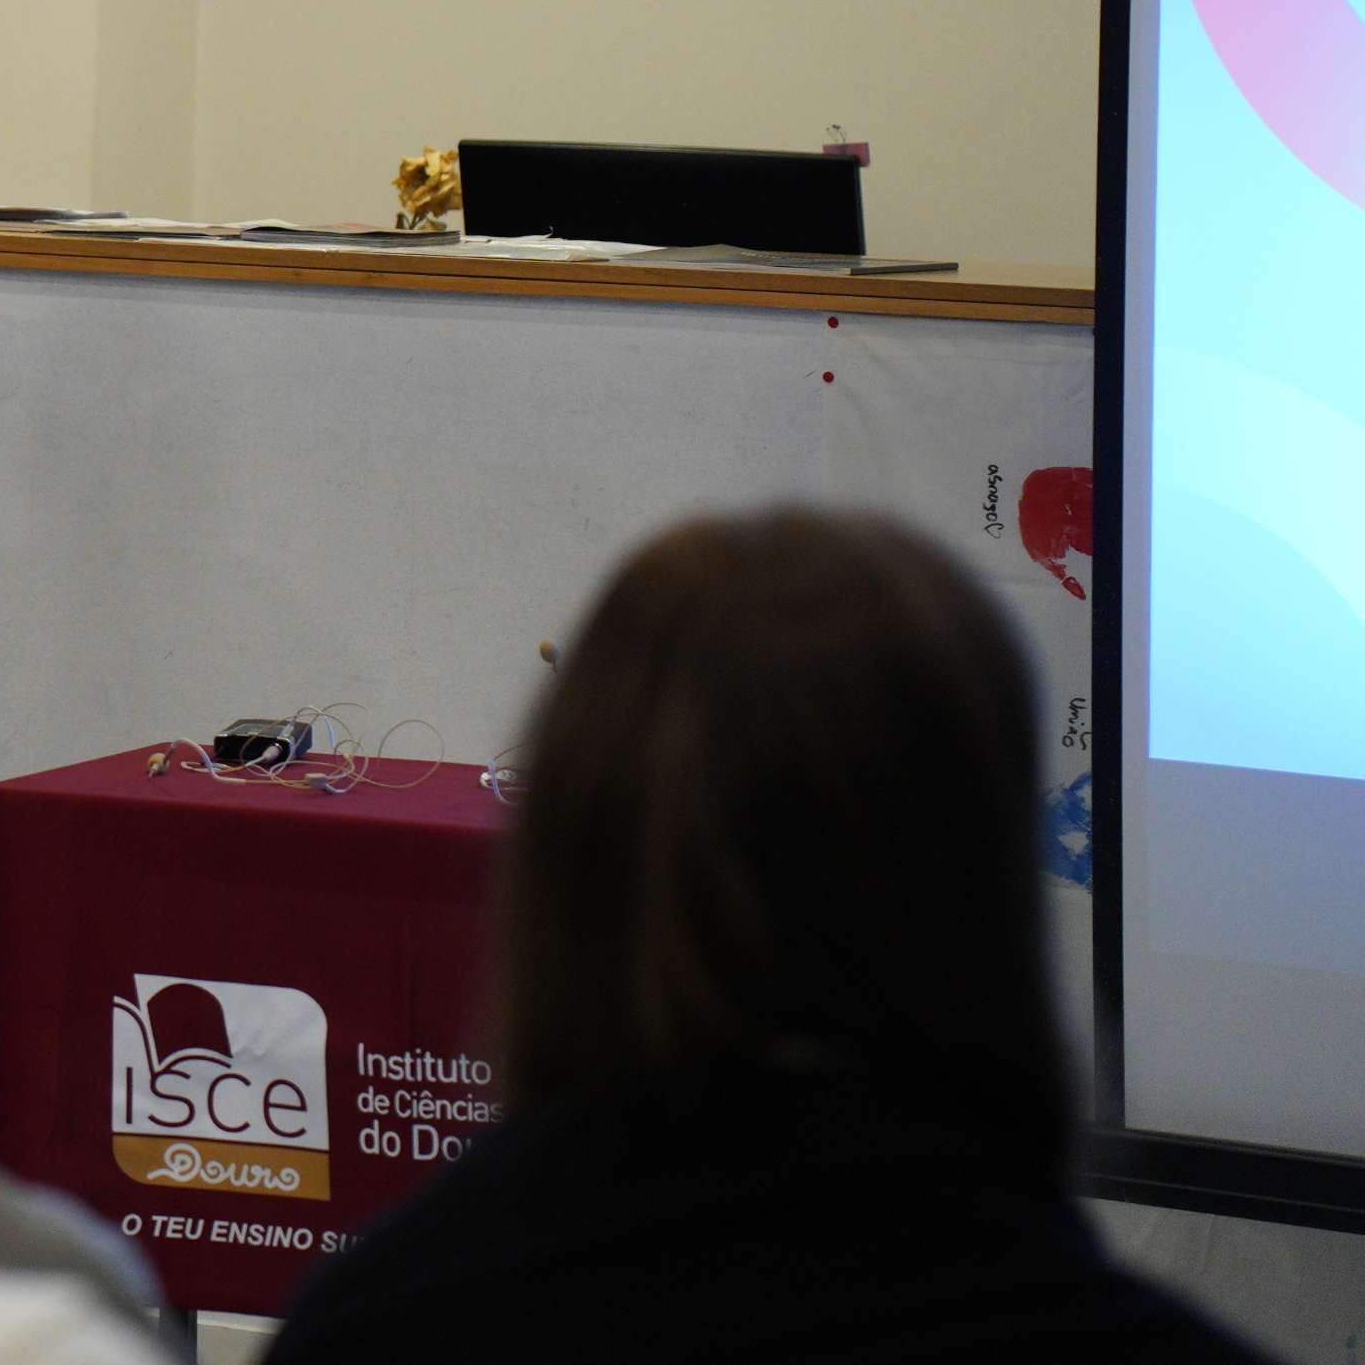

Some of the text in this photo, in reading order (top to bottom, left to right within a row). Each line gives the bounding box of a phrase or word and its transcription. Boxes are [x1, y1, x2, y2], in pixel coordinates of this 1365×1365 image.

[357, 1042, 493, 1086] Instituto
[357, 1086, 505, 1125] de Ciências
[359, 1124, 402, 1158] do
[147, 1142, 301, 1192] Douro
[121, 1213, 144, 1237] O
[150, 1215, 206, 1242] TEU
[209, 1219, 315, 1251] ENSINO
